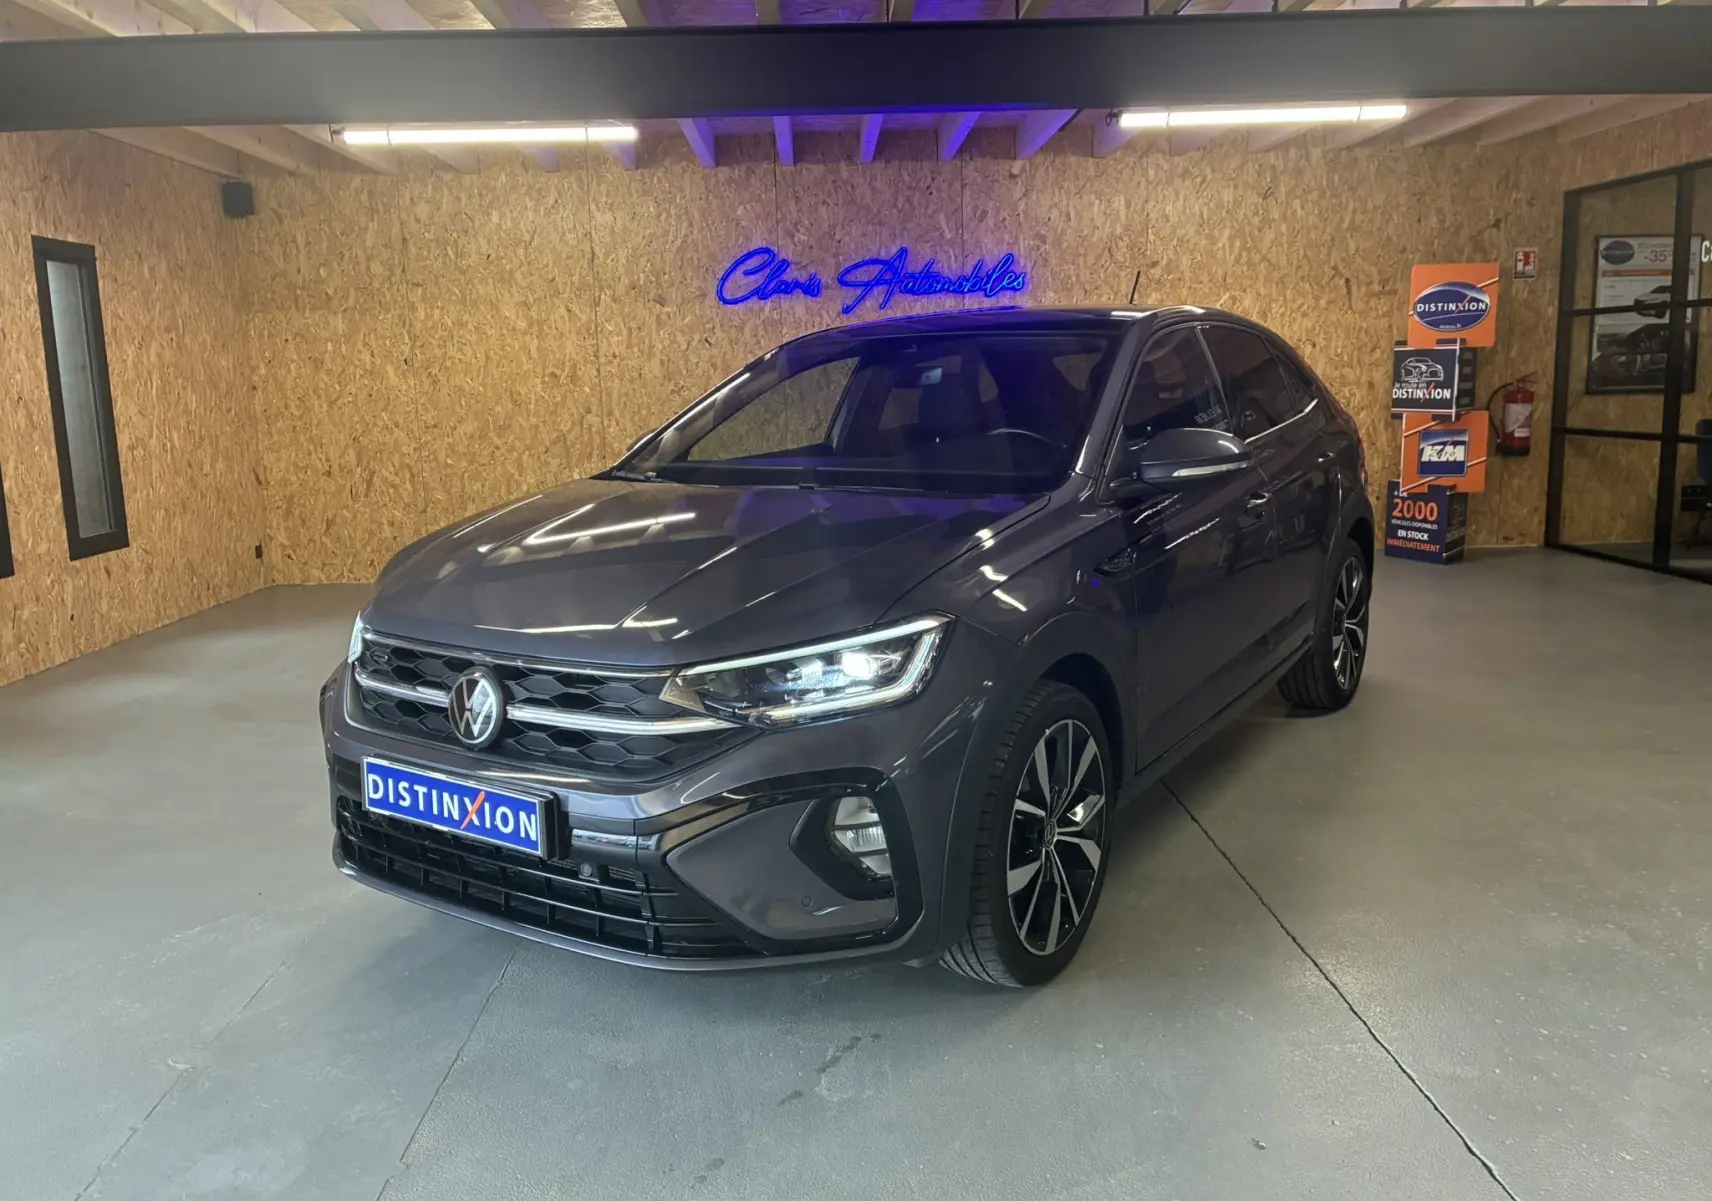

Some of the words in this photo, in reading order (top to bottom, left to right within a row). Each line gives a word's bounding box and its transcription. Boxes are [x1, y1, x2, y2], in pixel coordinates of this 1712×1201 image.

[1701, 240, 1712, 263] C
[837, 245, 1027, 314] Automobiles
[1416, 299, 1487, 313] DISTINXION
[1392, 386, 1451, 400] DISTINXION
[1392, 498, 1438, 521] 2000
[1407, 530, 1429, 541] STOCK
[367, 773, 537, 842] DISTINXION
